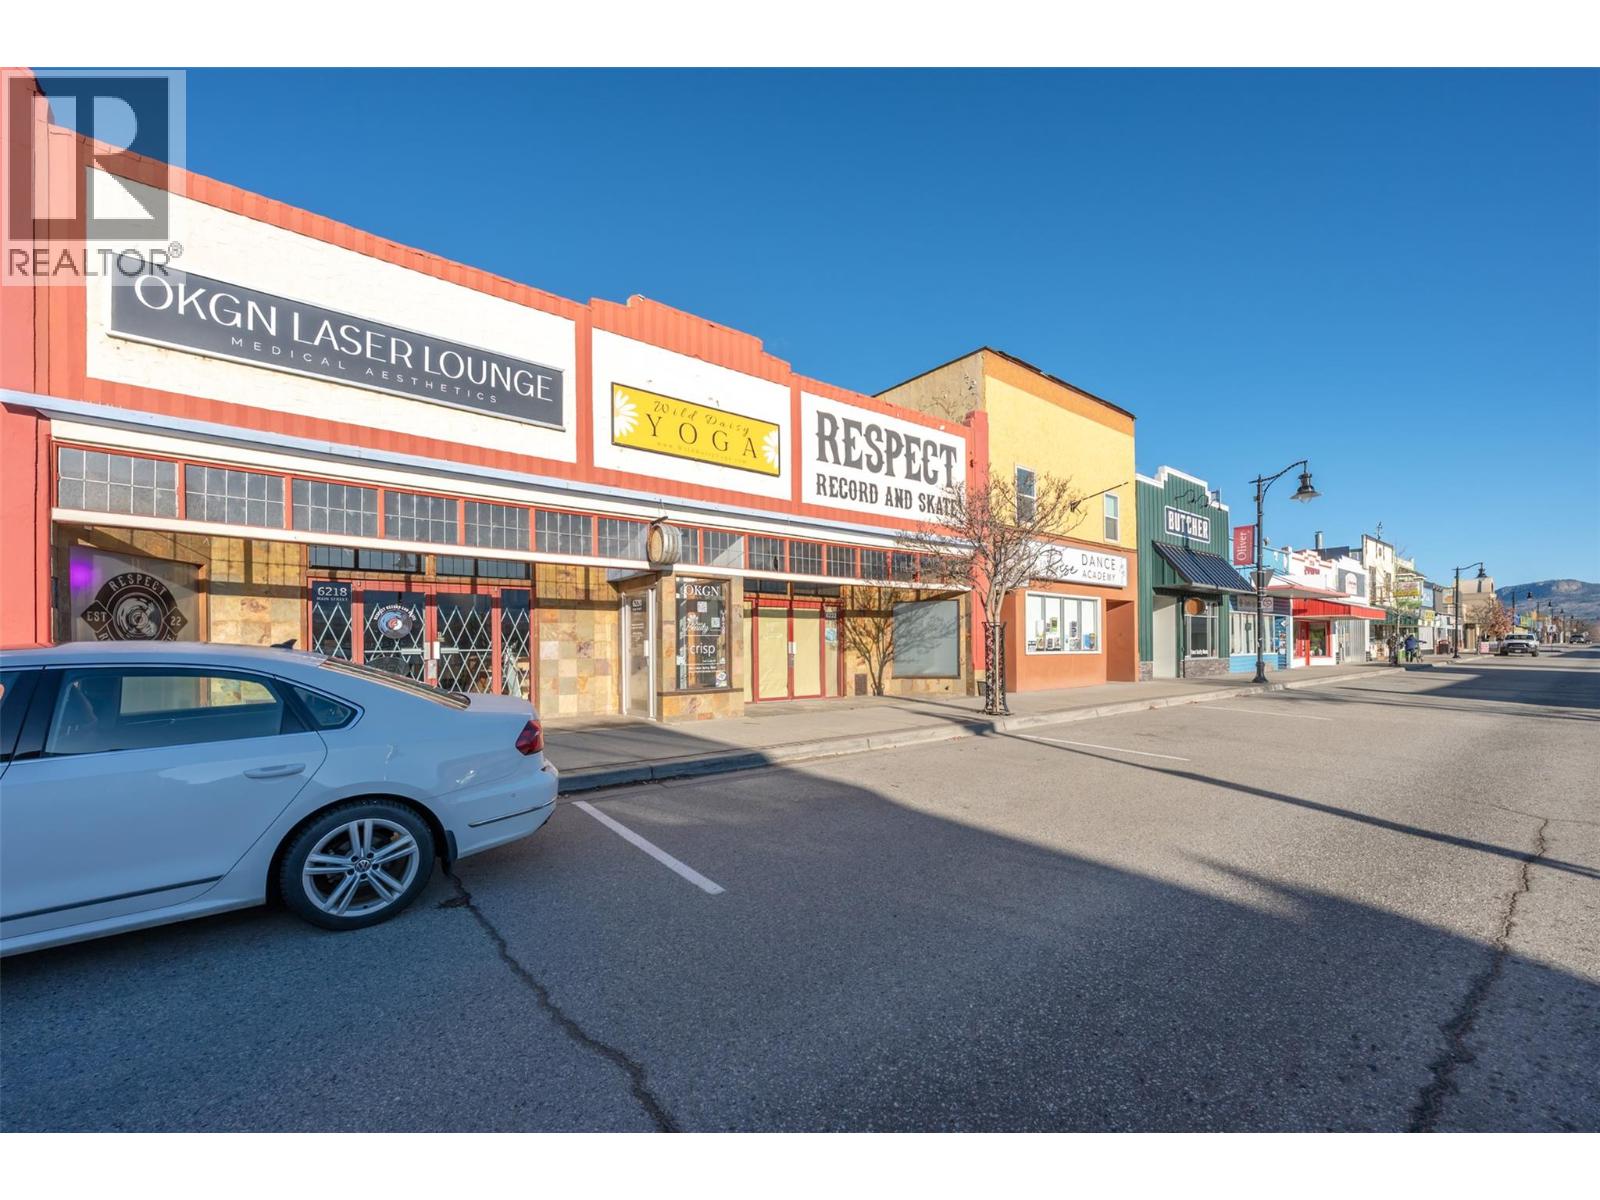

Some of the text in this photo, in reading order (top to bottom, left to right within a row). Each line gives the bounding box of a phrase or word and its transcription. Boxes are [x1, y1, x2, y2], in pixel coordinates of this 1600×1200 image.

[134, 274, 553, 402] OKGN LASER LOUNGE
[231, 336, 497, 404] MEDICAL AESTHETICS
[653, 400, 750, 437] Wild Daisy
[646, 413, 758, 459] YOGA
[816, 410, 957, 488] RESPECT
[816, 473, 958, 517] RECORD AND SKATE
[1168, 510, 1209, 538] BUTCHER
[1237, 532, 1248, 561] Oliver
[1081, 553, 1116, 570] DANCE
[1082, 569, 1116, 581] ACADEMY
[108, 573, 168, 596] RESPECT
[317, 586, 348, 597] 6218
[86, 610, 108, 622] EST
[170, 615, 182, 626] 22
[690, 642, 716, 657] crisp
